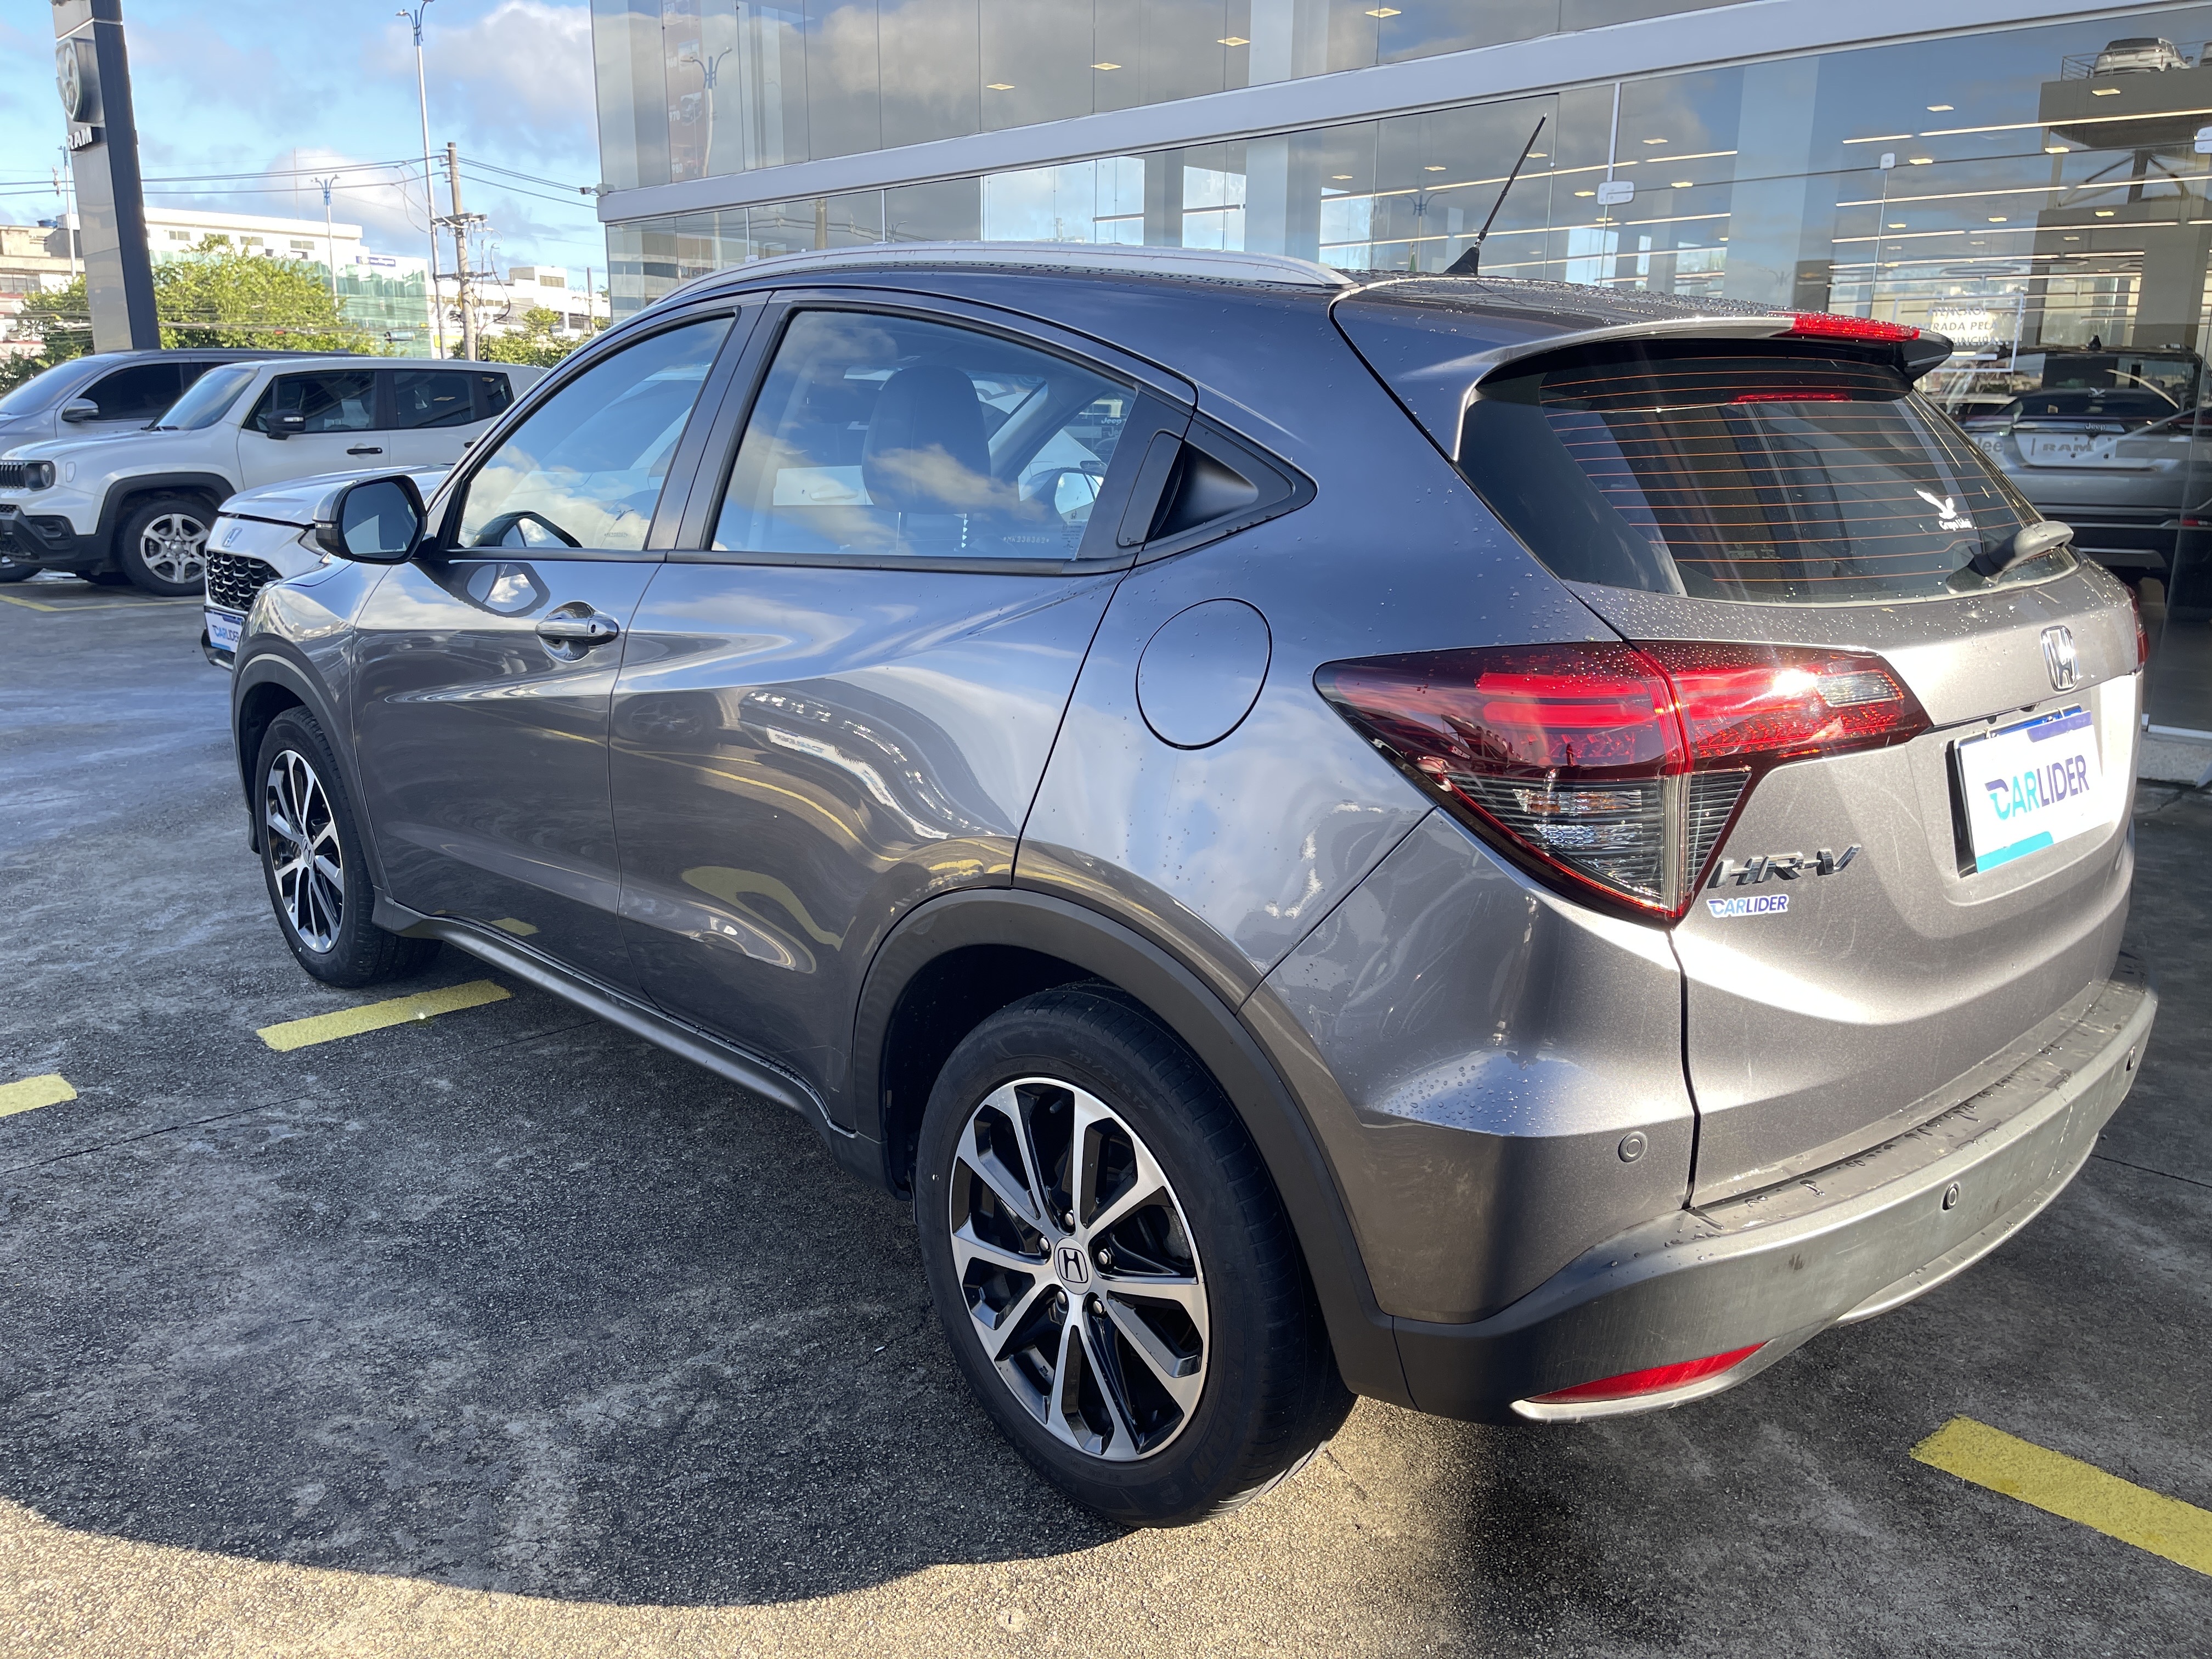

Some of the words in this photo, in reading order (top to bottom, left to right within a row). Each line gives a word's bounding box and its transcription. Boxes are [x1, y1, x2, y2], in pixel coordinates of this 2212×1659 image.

[66, 126, 93, 150] RAM
[1101, 417, 1122, 426] Jeep
[2085, 422, 2106, 431] Jeep
[1984, 754, 2090, 820] CARLIDER
[1706, 844, 1862, 889] HR-V
[1708, 896, 1788, 916] CARLIDER
